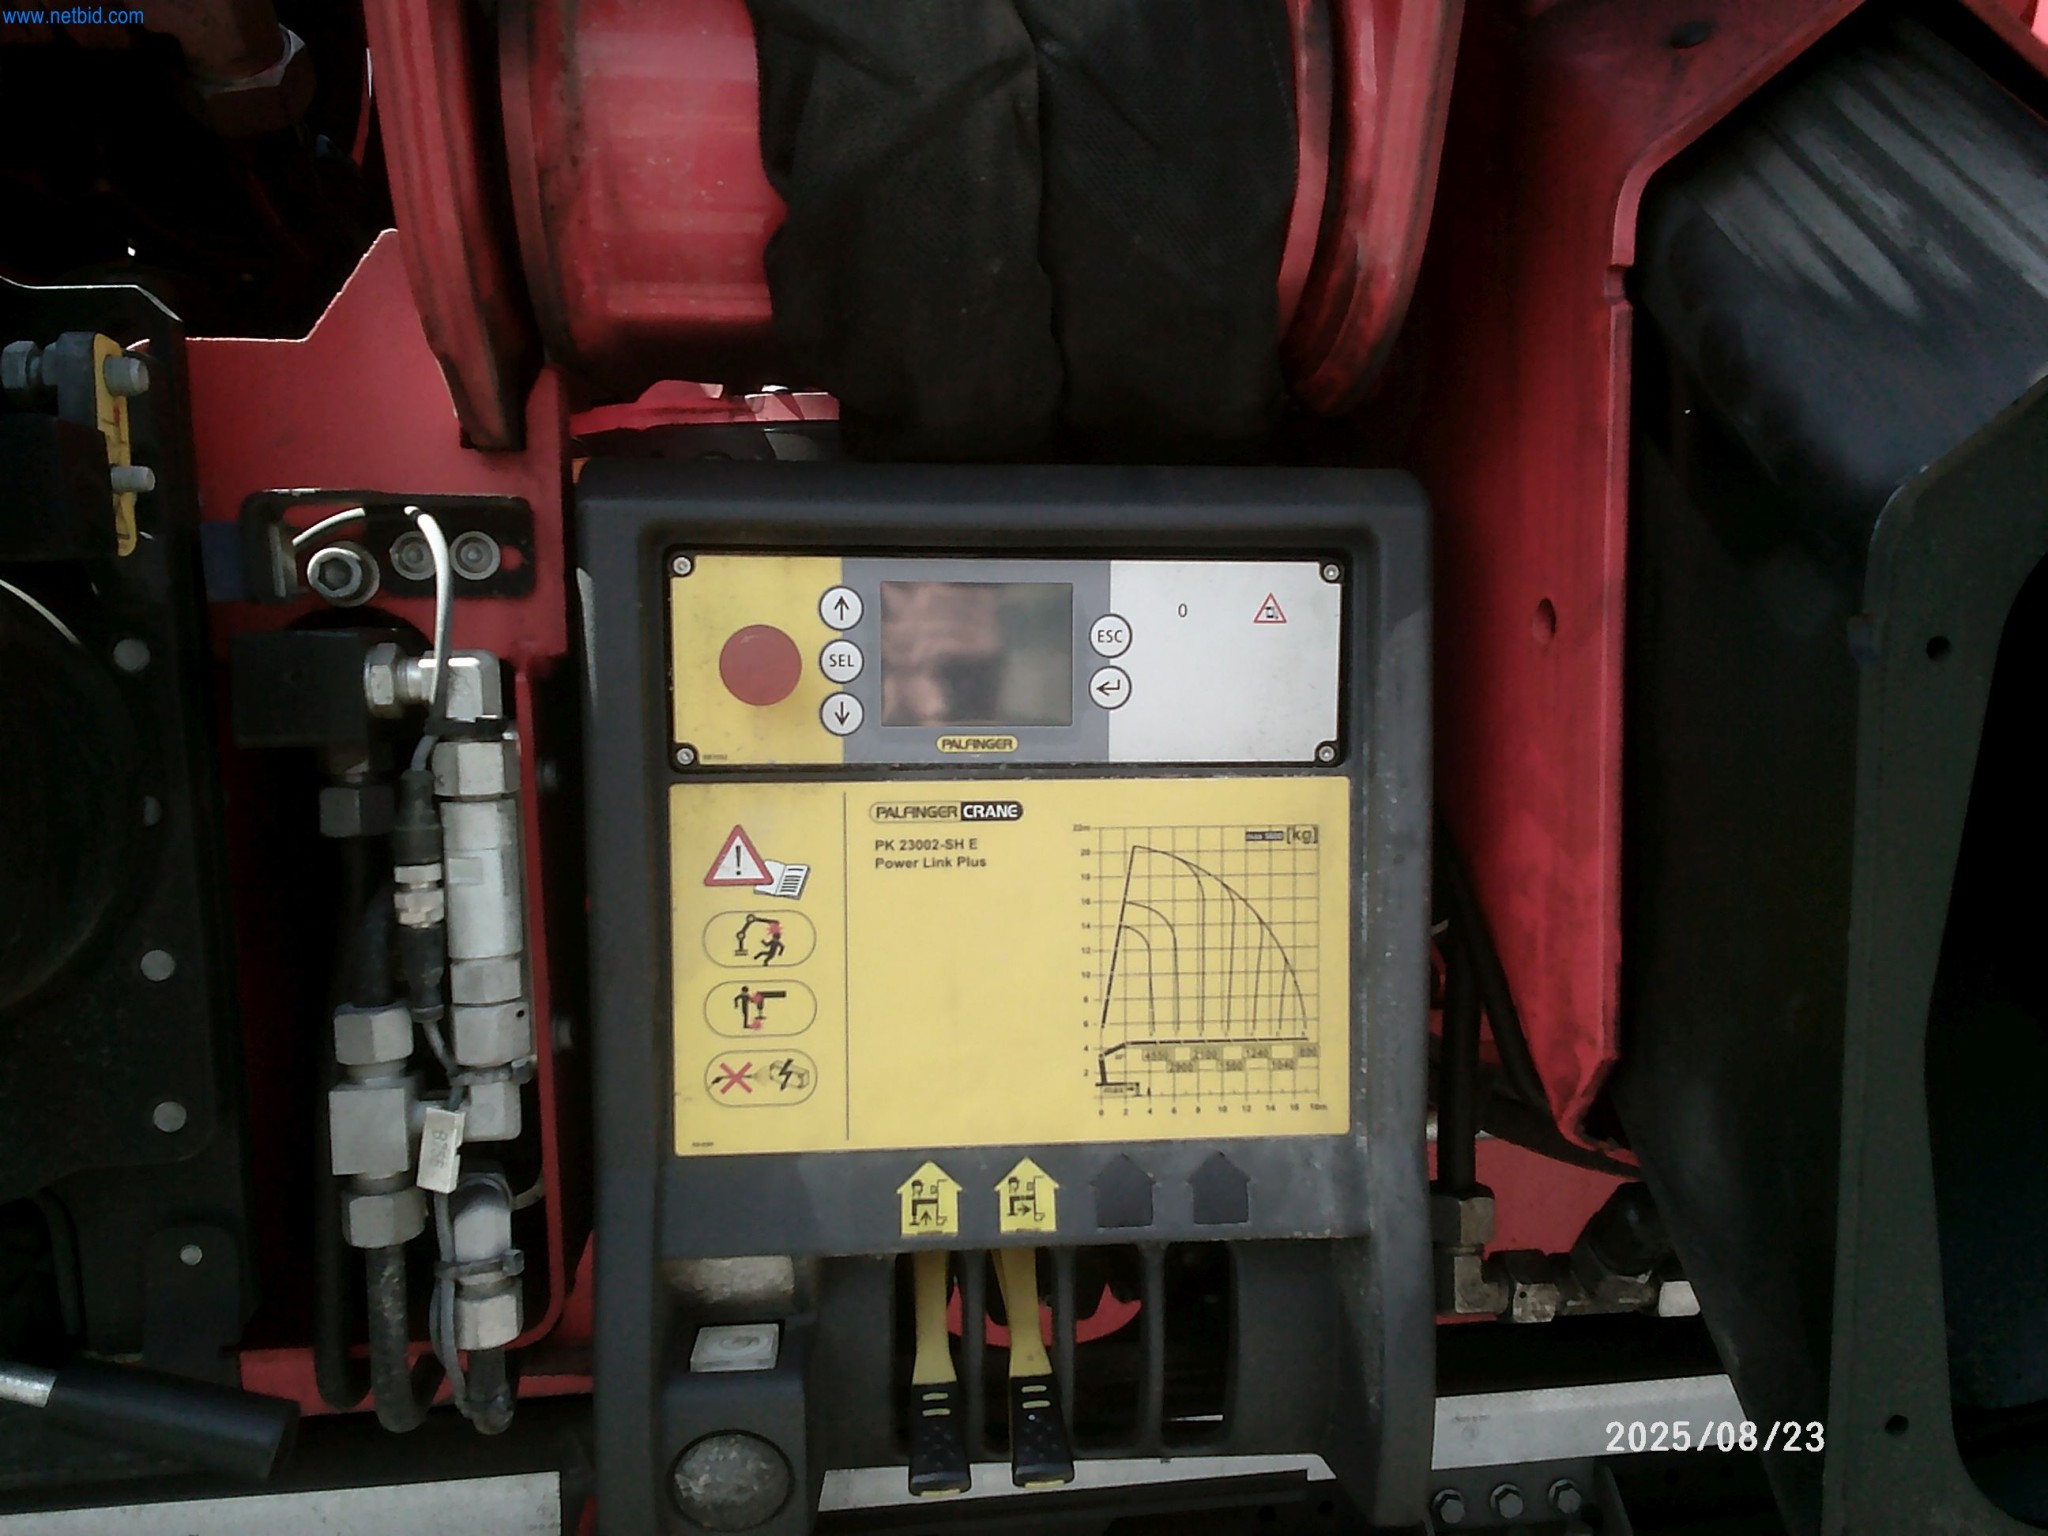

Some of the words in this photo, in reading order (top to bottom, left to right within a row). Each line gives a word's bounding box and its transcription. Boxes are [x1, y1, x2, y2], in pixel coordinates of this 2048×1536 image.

[1097, 629, 1123, 643] ESC
[829, 654, 854, 668] SEL
[942, 738, 1013, 750] PALFINGER
[876, 805, 958, 819] PALFINGER
[963, 804, 1018, 818] CRANE
[875, 839, 895, 851] PK
[900, 838, 965, 850] 23002-SH
[969, 838, 978, 849] E
[875, 857, 919, 870] Power
[923, 856, 953, 869] Link
[957, 855, 987, 868] Plus
